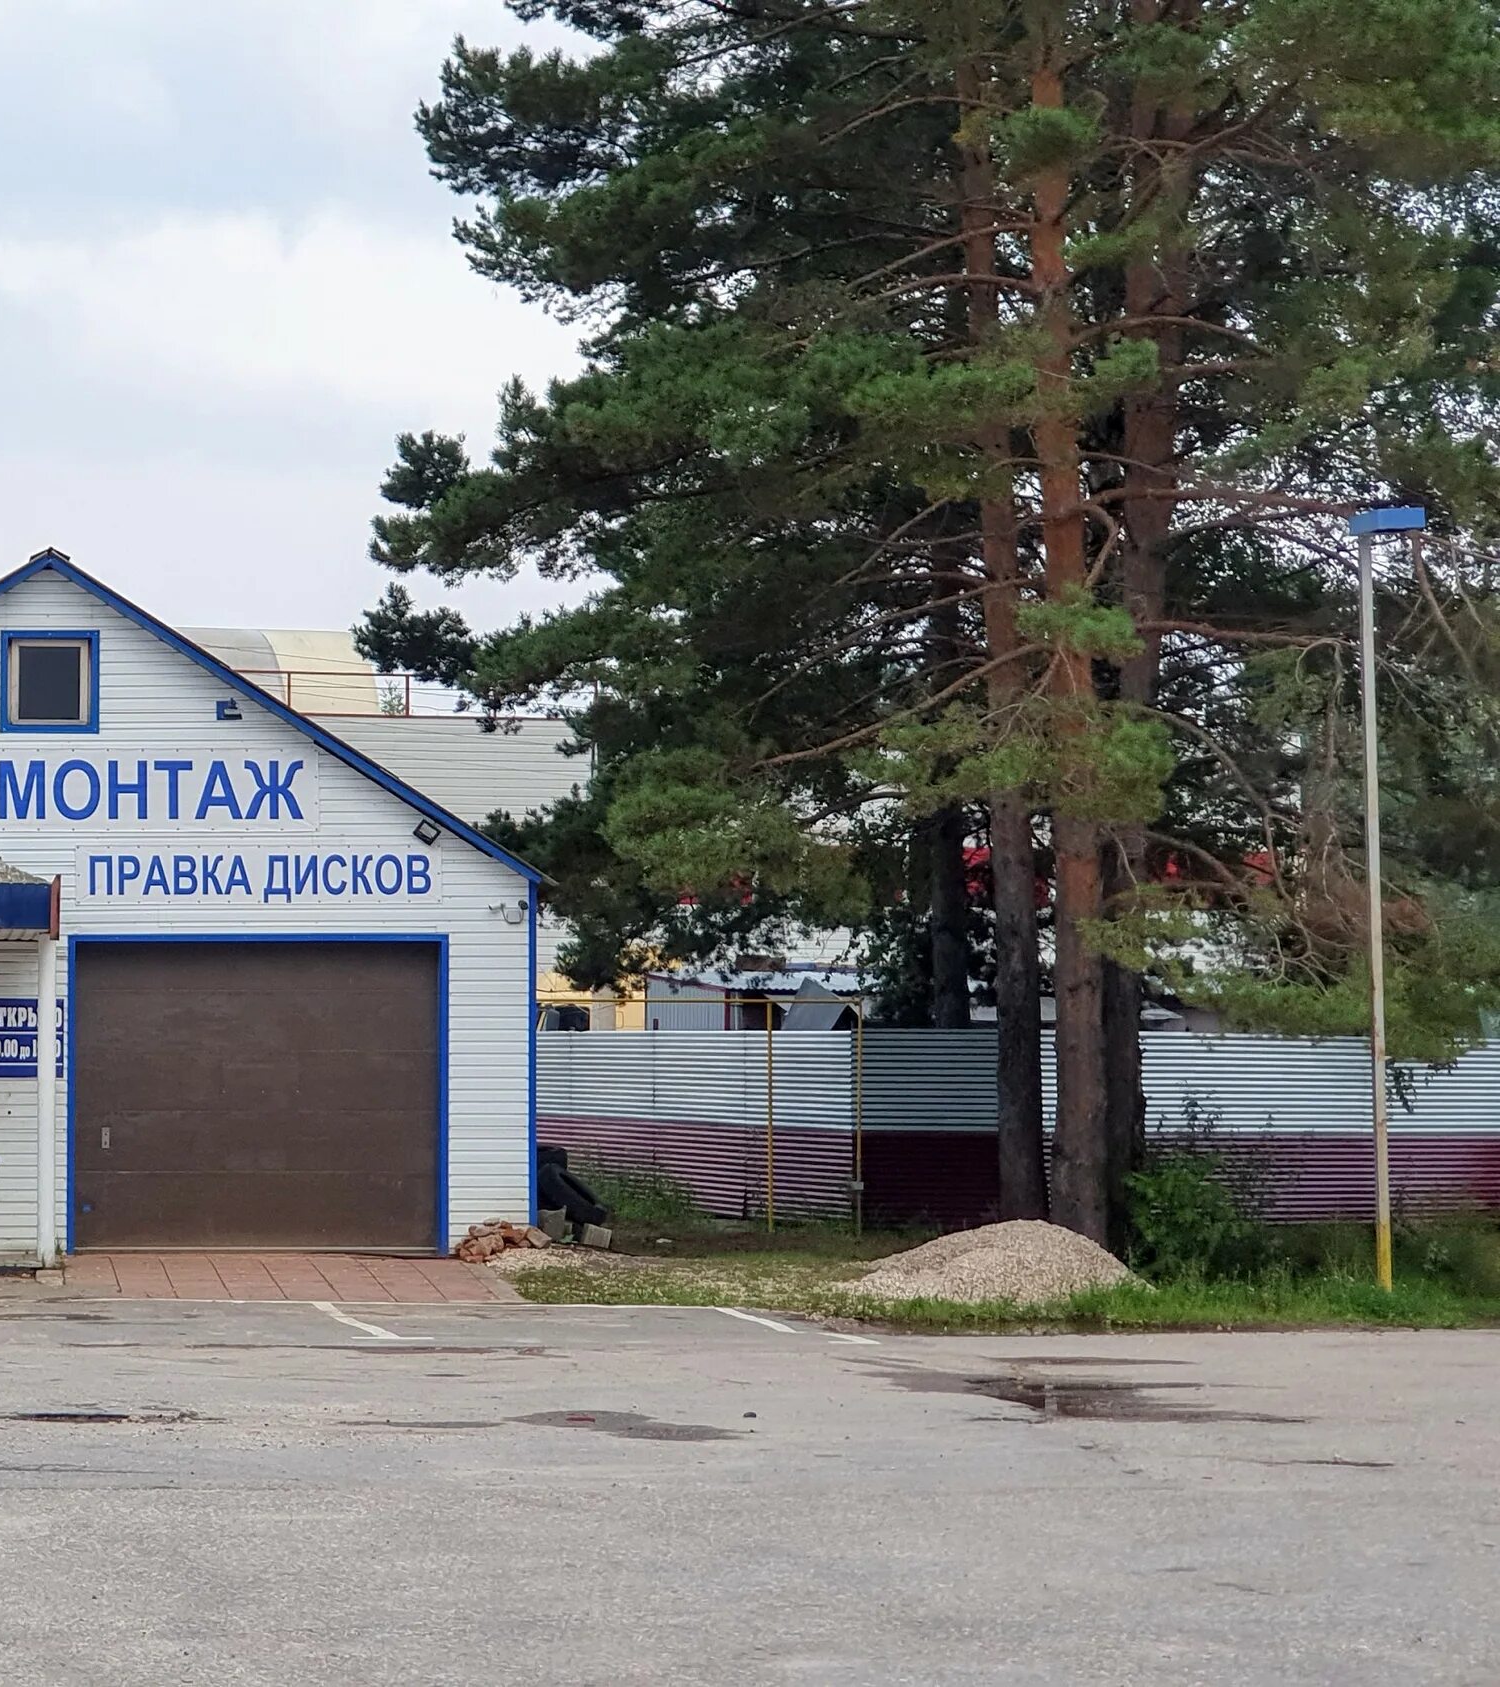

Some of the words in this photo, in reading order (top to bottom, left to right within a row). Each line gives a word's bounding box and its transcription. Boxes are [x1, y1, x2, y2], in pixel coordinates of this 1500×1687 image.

[88, 855, 252, 896] ПРАВКА
[263, 854, 431, 903] ДИСКОВ
[19, 1046, 31, 1060] до
